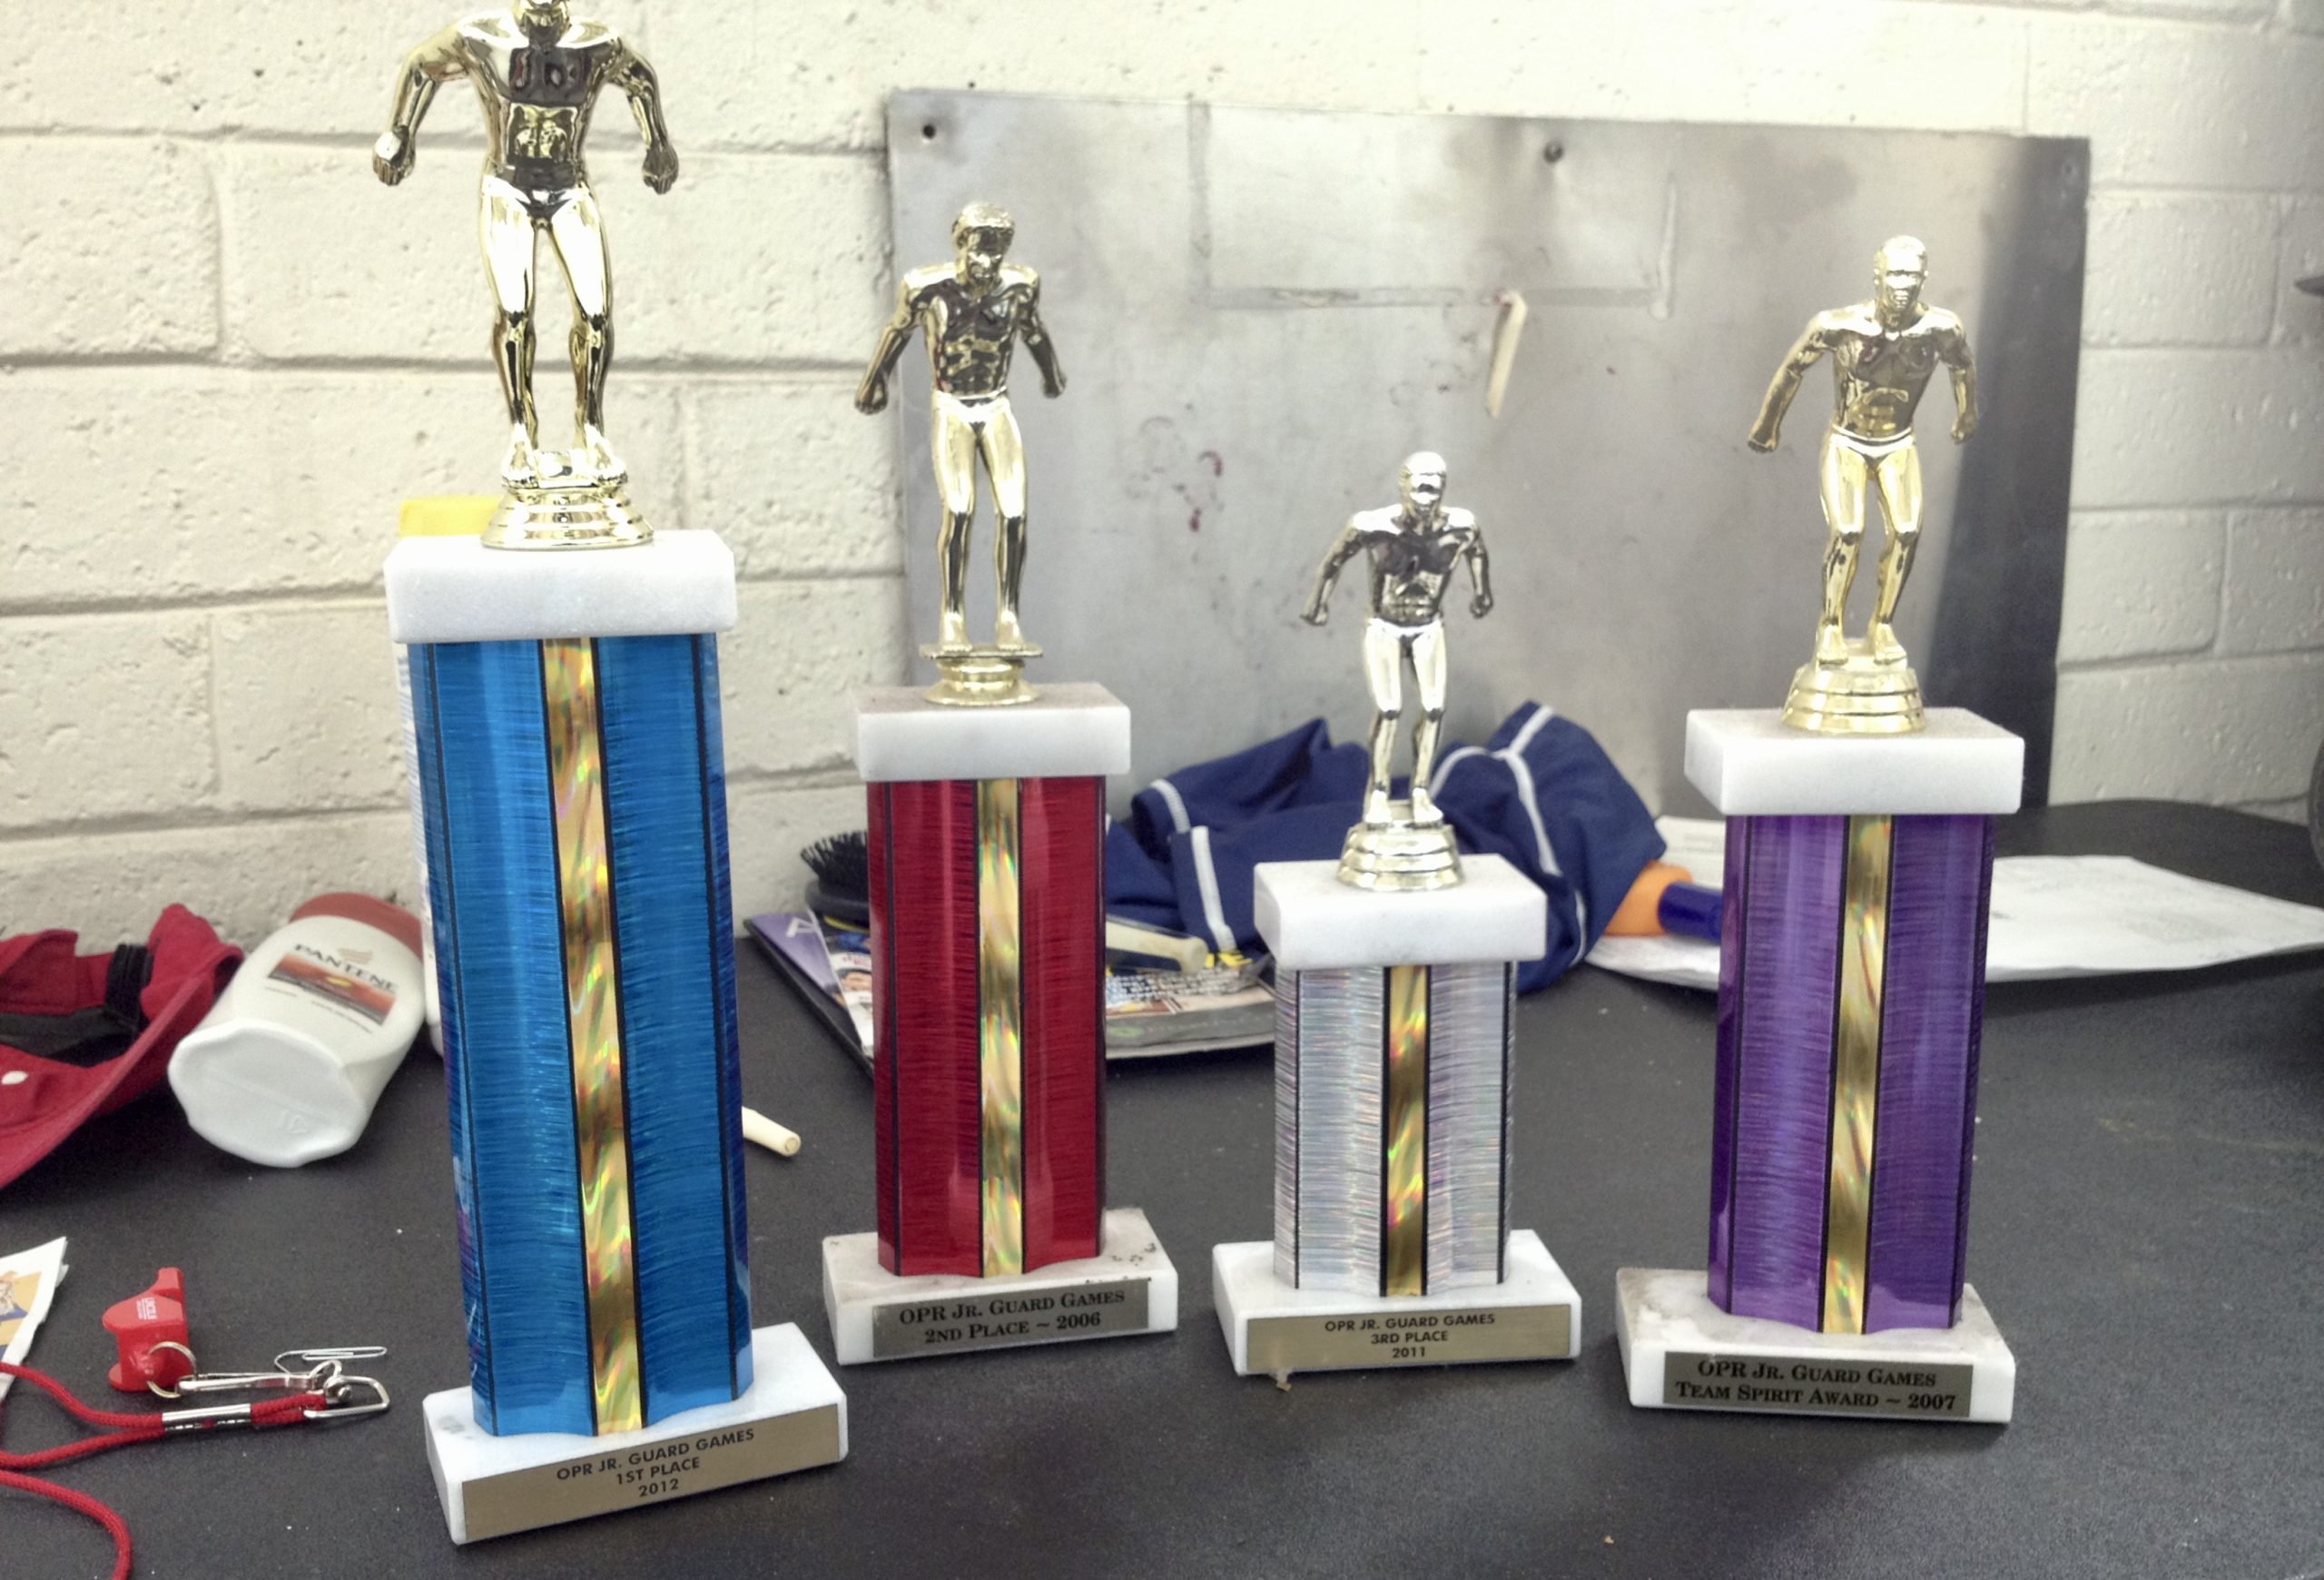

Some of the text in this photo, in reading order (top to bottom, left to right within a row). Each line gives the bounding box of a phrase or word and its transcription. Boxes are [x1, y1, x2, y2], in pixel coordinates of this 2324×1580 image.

[294, 943, 399, 992] PANTENE
[899, 1307, 946, 1326] OPR
[989, 1294, 1055, 1317] GUARD
[1060, 1290, 1125, 1309] GAMES
[1324, 1313, 1495, 1332] OPR JR. GUARD GAMES
[924, 1327, 962, 1344] 2ND
[969, 1320, 1029, 1340] PLACE
[1057, 1312, 1101, 1331] 2006
[1371, 1330, 1448, 1345] 3RD PLACE
[1392, 1348, 1426, 1359] 2011
[1697, 1359, 1748, 1378] OPR
[1791, 1366, 1861, 1384] GUARD
[1866, 1369, 1936, 1387] GAMES
[1676, 1381, 1730, 1400] TEAM
[1737, 1384, 1804, 1403] SPIRIT
[1808, 1387, 1879, 1408] AWARD
[1906, 1392, 1956, 1410] 2007
[556, 1428, 755, 1481] OPR JR. GUARD GAMES
[616, 1457, 701, 1486] 1ST PLACE
[638, 1477, 680, 1497] 2012
